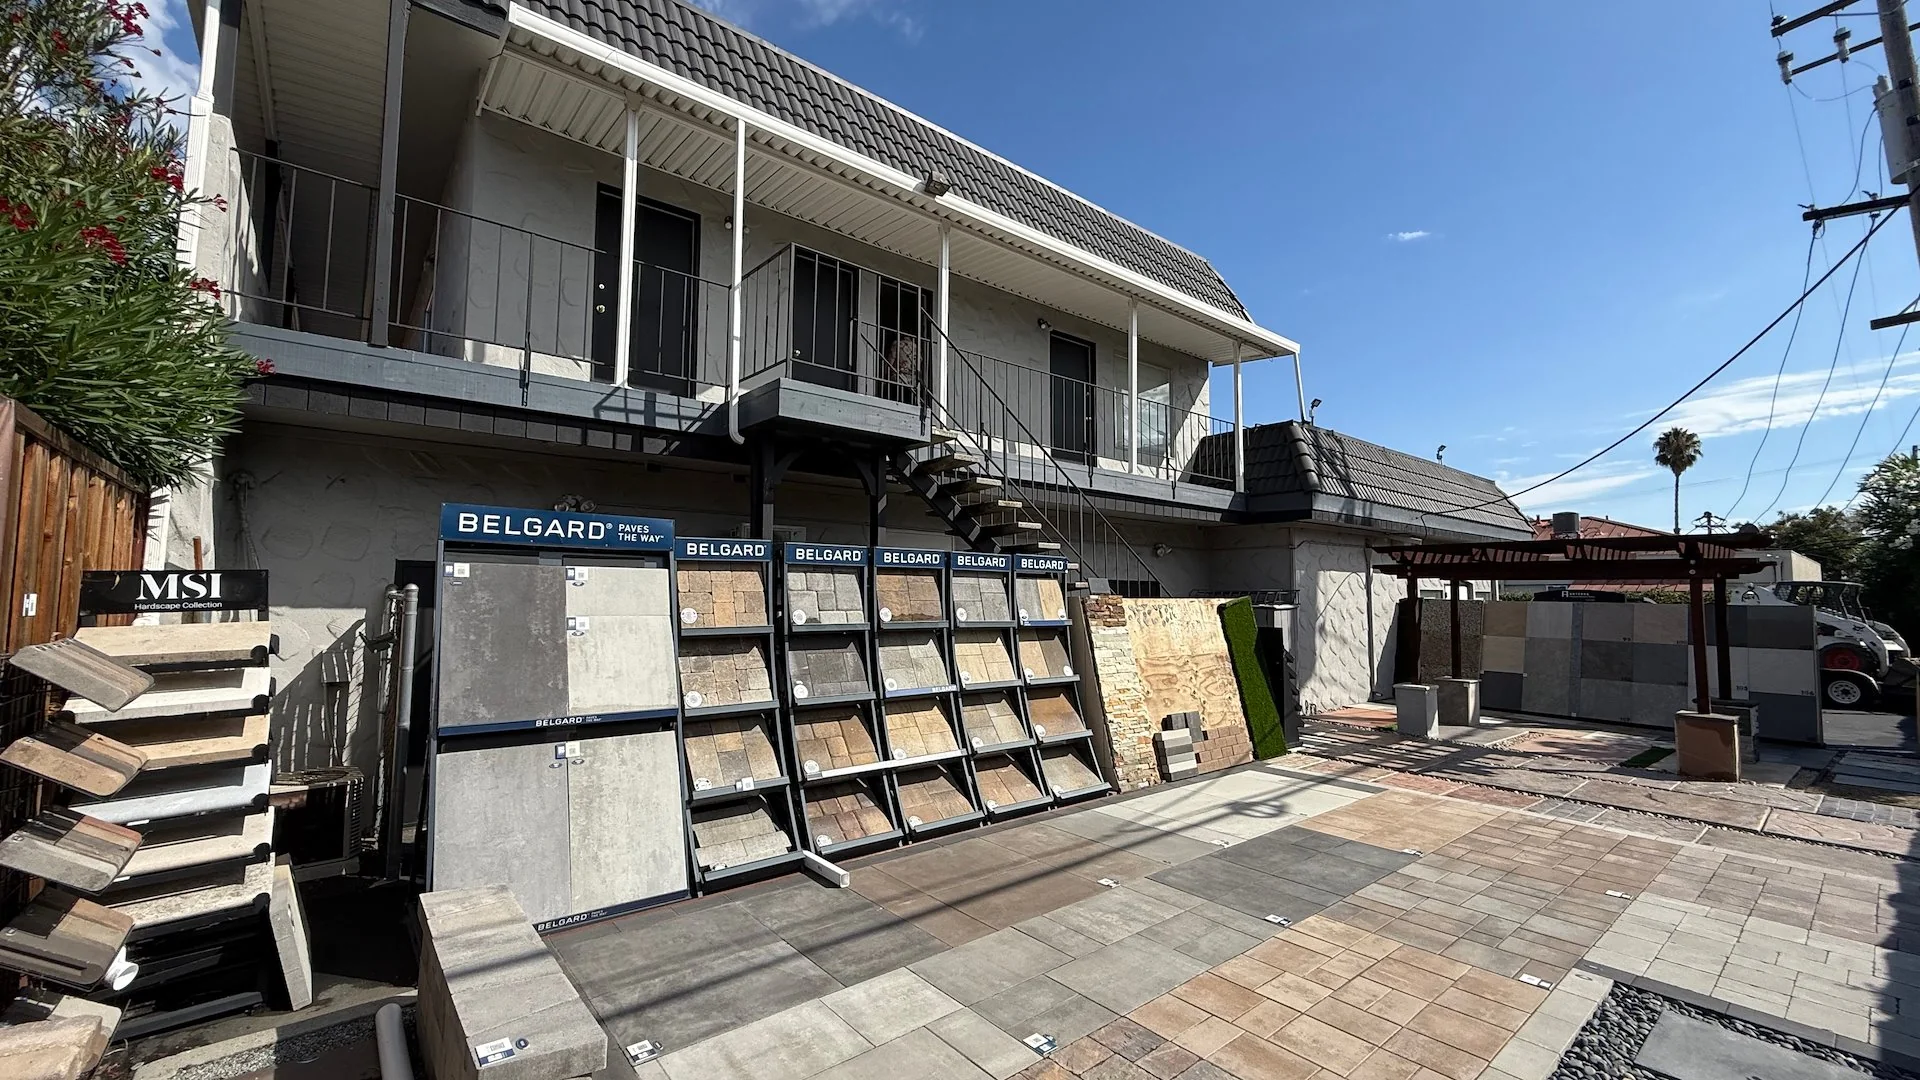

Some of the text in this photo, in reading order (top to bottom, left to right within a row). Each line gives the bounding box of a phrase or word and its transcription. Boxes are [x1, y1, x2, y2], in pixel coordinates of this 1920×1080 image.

[618, 523, 650, 534] PAVES
[618, 533, 638, 542] THE
[686, 542, 765, 557] BELGARD
[795, 548, 862, 562] BELGARD
[883, 552, 940, 565] BELGARD
[957, 555, 1006, 568] BELGARD
[1020, 558, 1064, 570] BELGARD
[136, 573, 222, 600] MSI
[134, 601, 223, 611] Hardscape Collection
[535, 716, 583, 727] BELGARD
[537, 913, 588, 931] BELGARD
